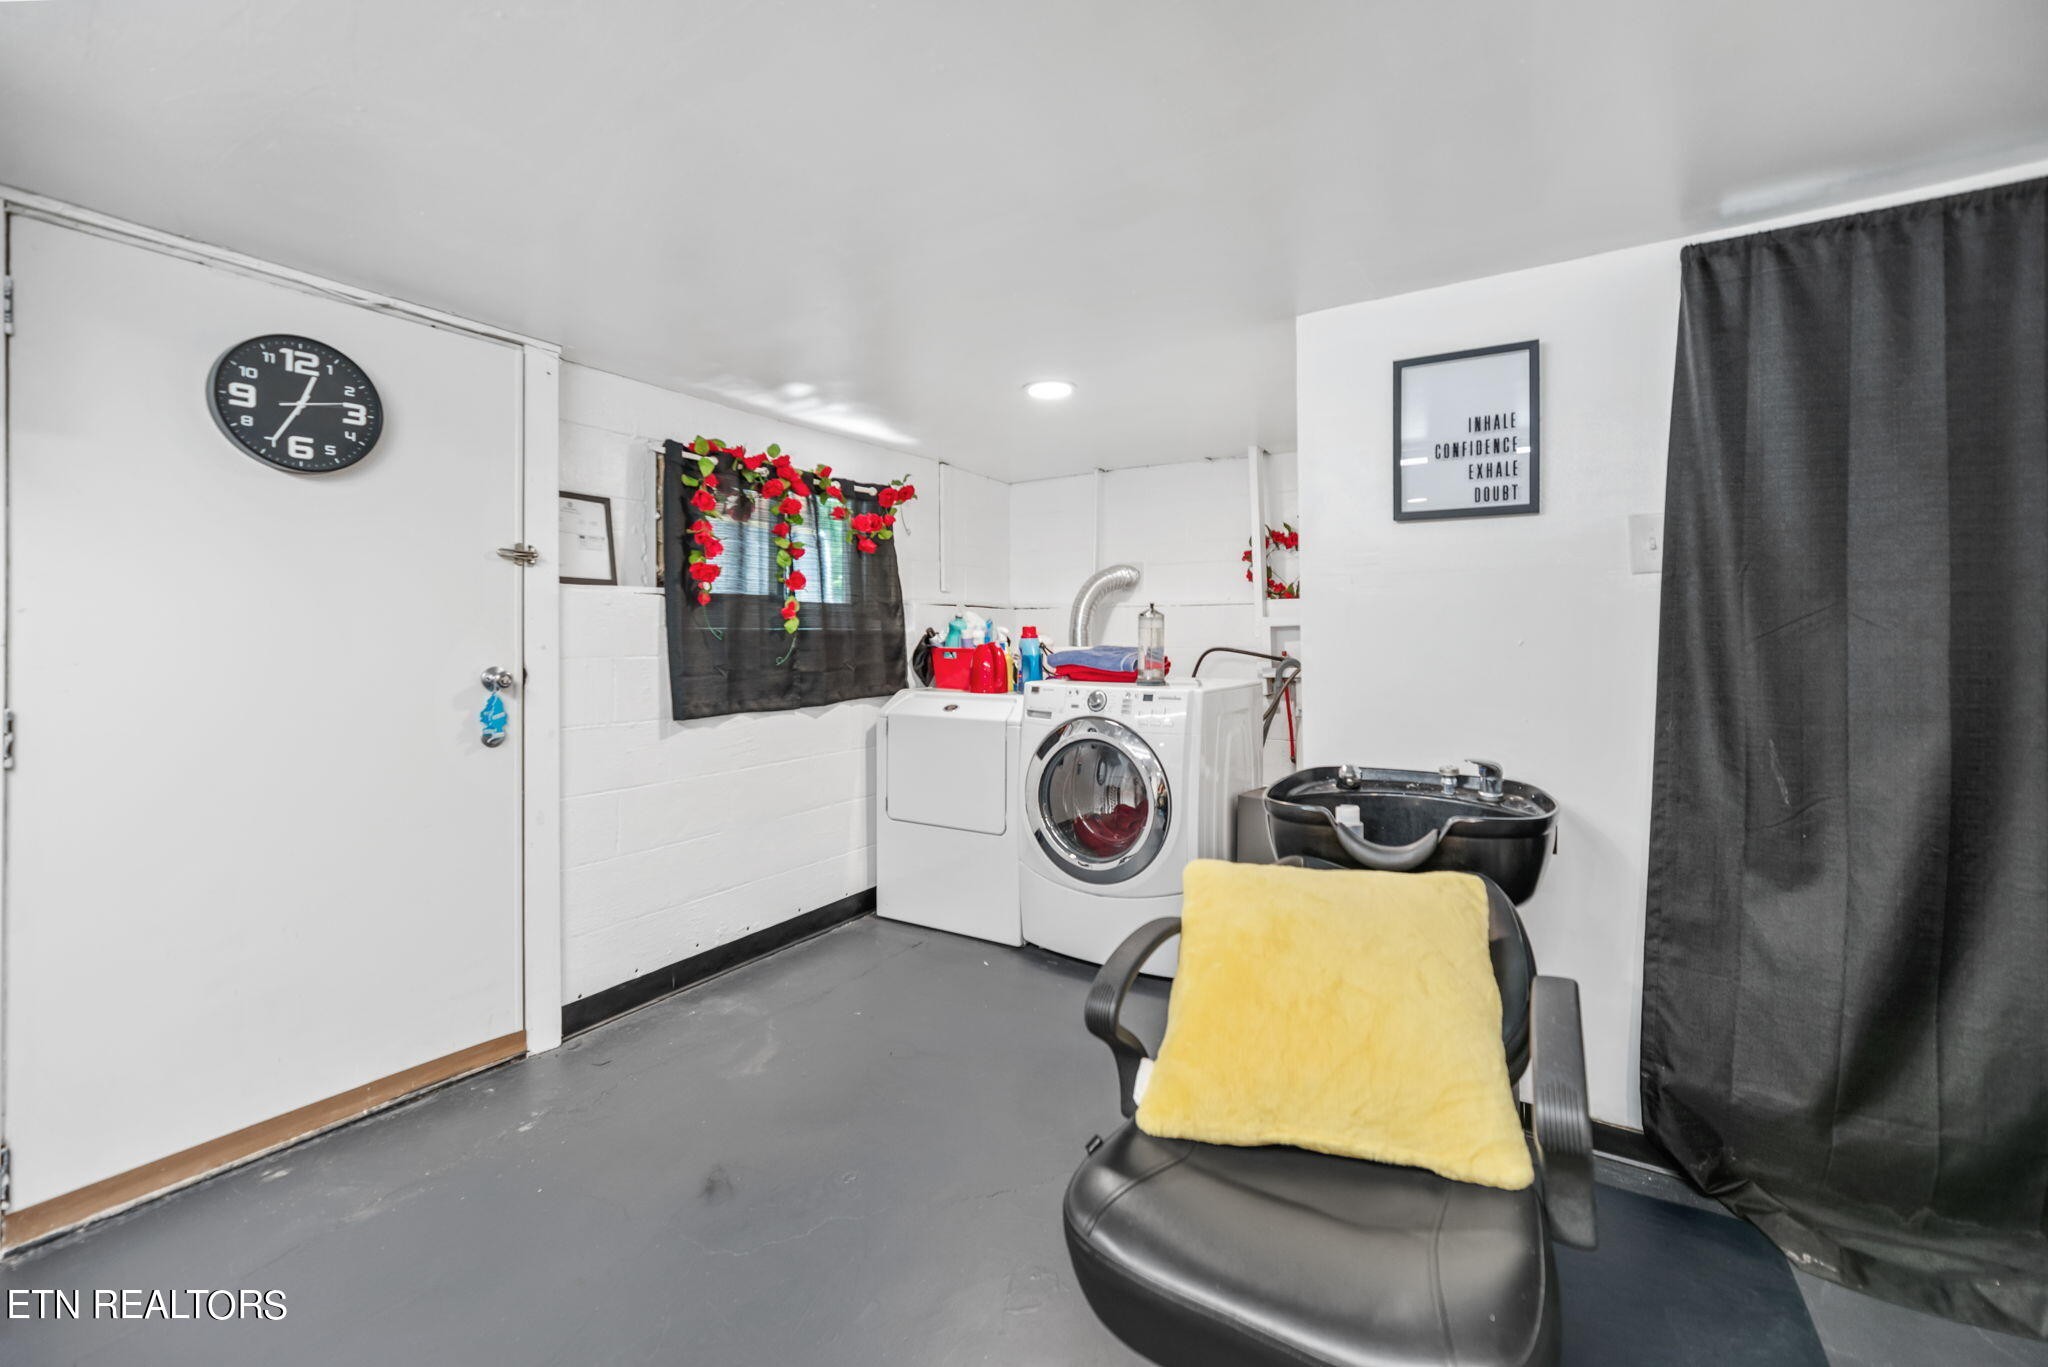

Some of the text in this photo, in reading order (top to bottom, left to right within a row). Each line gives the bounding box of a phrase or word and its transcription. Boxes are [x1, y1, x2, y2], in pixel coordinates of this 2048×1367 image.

[262, 351, 276, 364] 11
[279, 348, 320, 377] 12
[238, 365, 258, 379] 10
[326, 364, 334, 375] 1
[228, 382, 257, 408] 9
[344, 386, 355, 397] 2
[240, 415, 254, 427] 8
[342, 402, 367, 426] 3
[1468, 412, 1516, 433] INHALE
[344, 431, 356, 442] 4
[288, 435, 314, 460] 6
[324, 445, 336, 456] 5
[1435, 436, 1518, 459] CONFIDENCE
[1468, 460, 1518, 480] EXHALE
[1474, 484, 1519, 503] DOUBT
